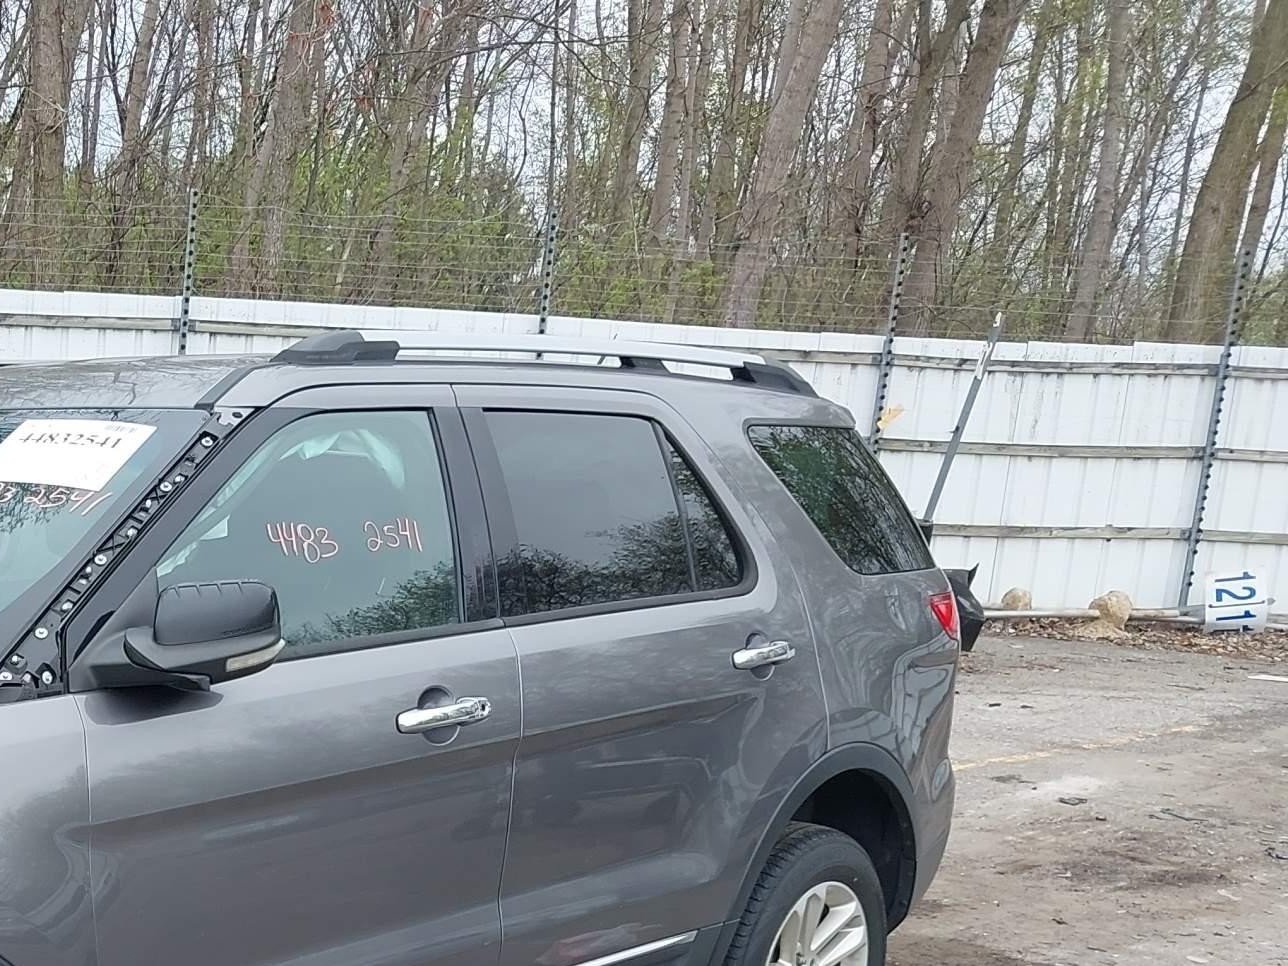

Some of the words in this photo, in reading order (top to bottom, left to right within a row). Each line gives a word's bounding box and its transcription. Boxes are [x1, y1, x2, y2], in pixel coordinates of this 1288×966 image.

[19, 432, 122, 448] 44832541
[23, 486, 113, 516] 2541
[266, 521, 339, 563] 4483
[364, 517, 424, 553] 2541
